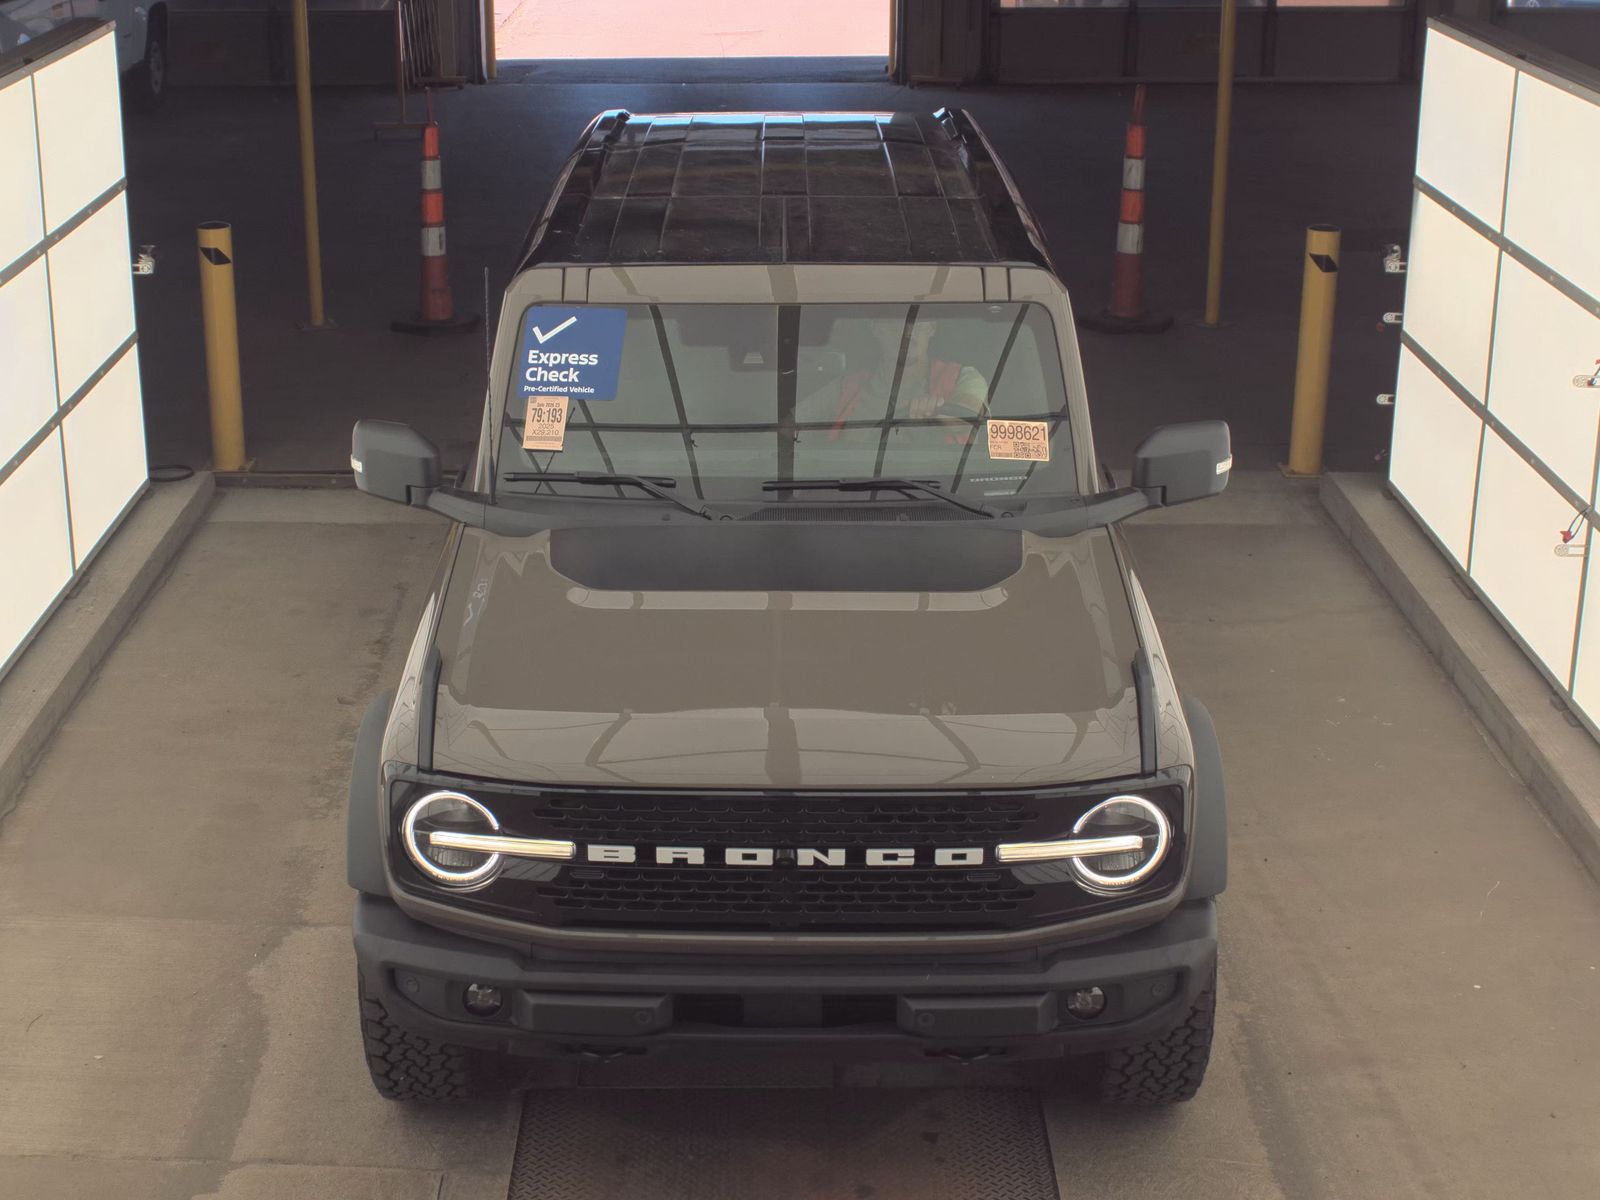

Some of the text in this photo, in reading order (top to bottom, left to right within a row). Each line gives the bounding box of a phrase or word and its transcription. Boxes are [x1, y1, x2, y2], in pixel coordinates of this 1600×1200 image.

[528, 349, 599, 367] Express
[525, 367, 580, 382] Check
[523, 385, 595, 394] Pre-Certified Vehicle
[990, 424, 1046, 441] 9998621
[587, 844, 984, 866] BRONCO
